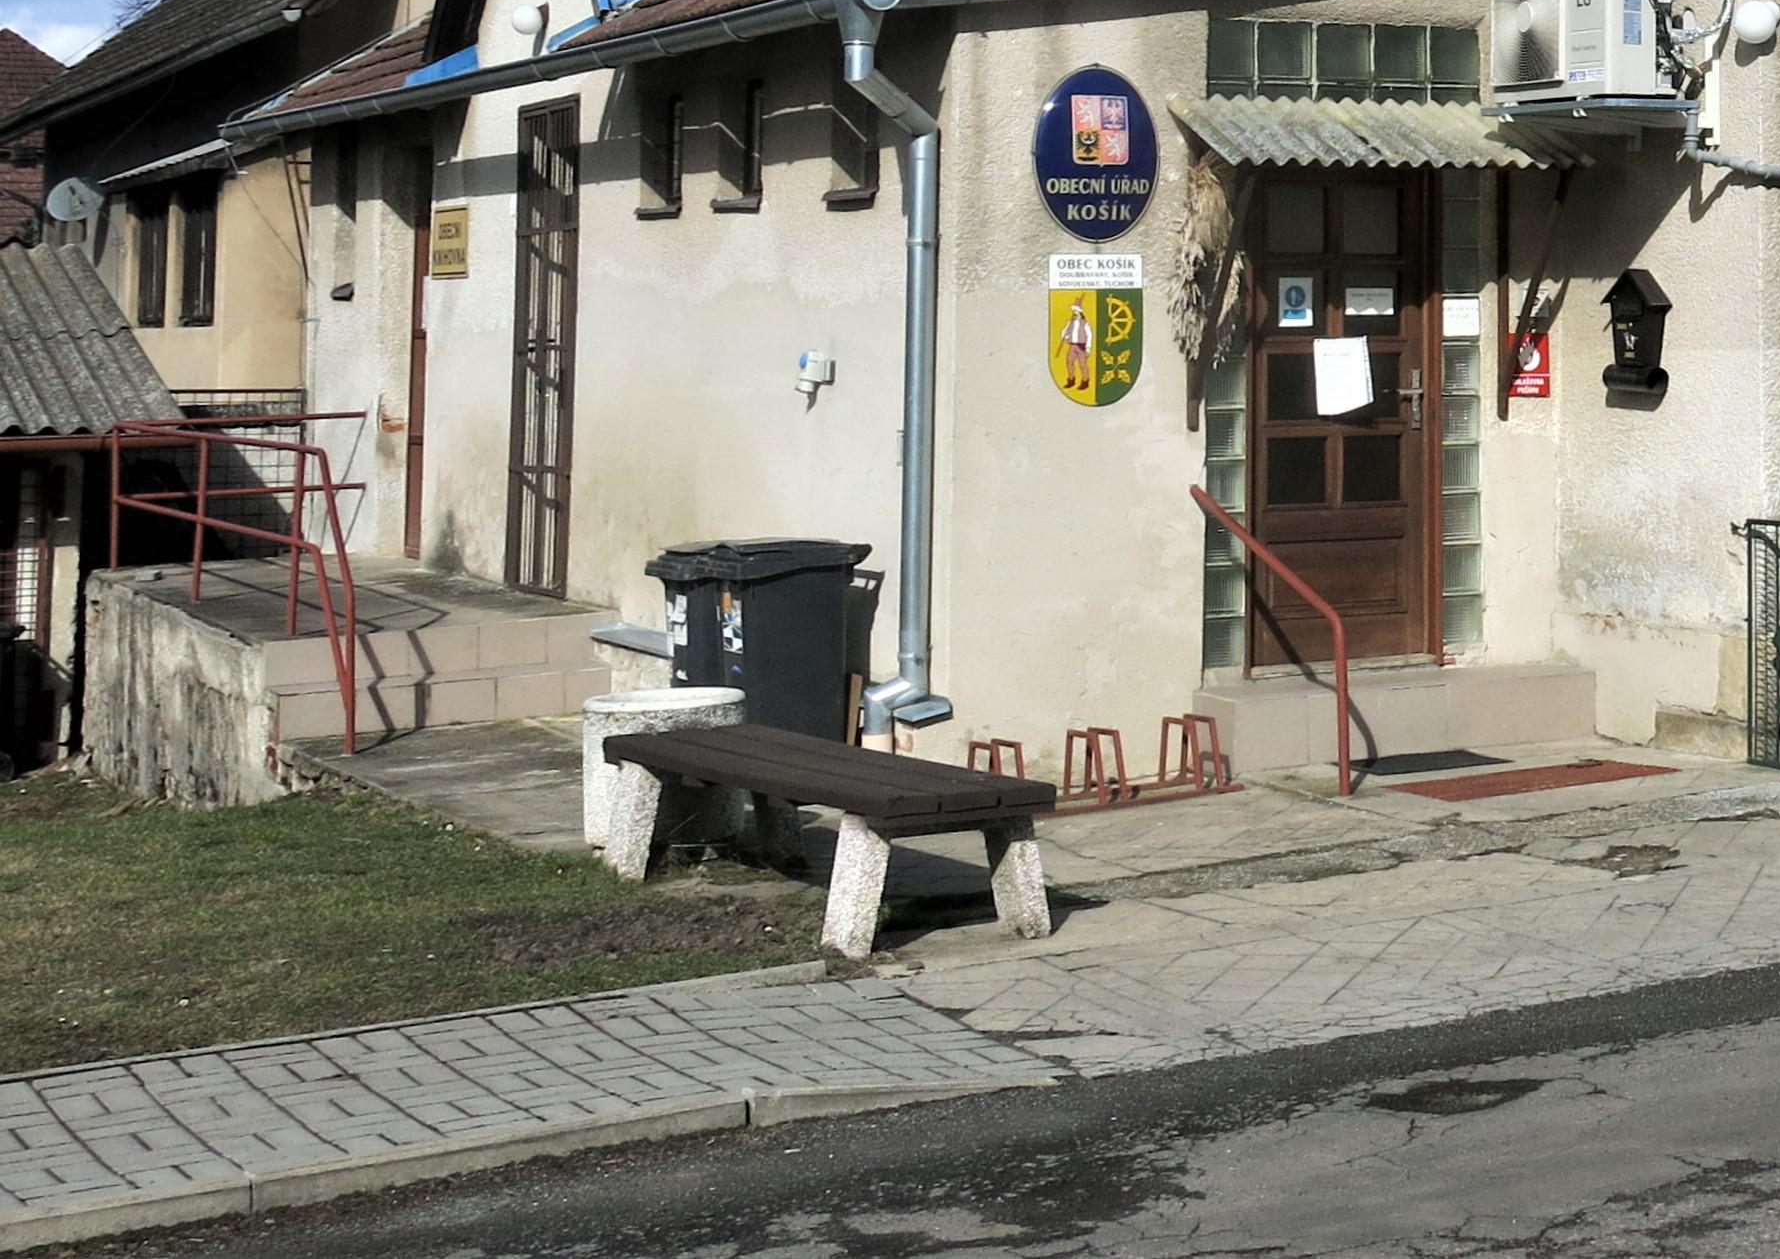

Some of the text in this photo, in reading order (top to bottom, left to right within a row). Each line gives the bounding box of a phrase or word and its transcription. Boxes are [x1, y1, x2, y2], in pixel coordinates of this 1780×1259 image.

[1046, 173, 1150, 194] OBECNÍ ÚŘAD
[1066, 199, 1132, 220] KOŠÍK
[1057, 256, 1136, 269] OBEC KOŠÍK
